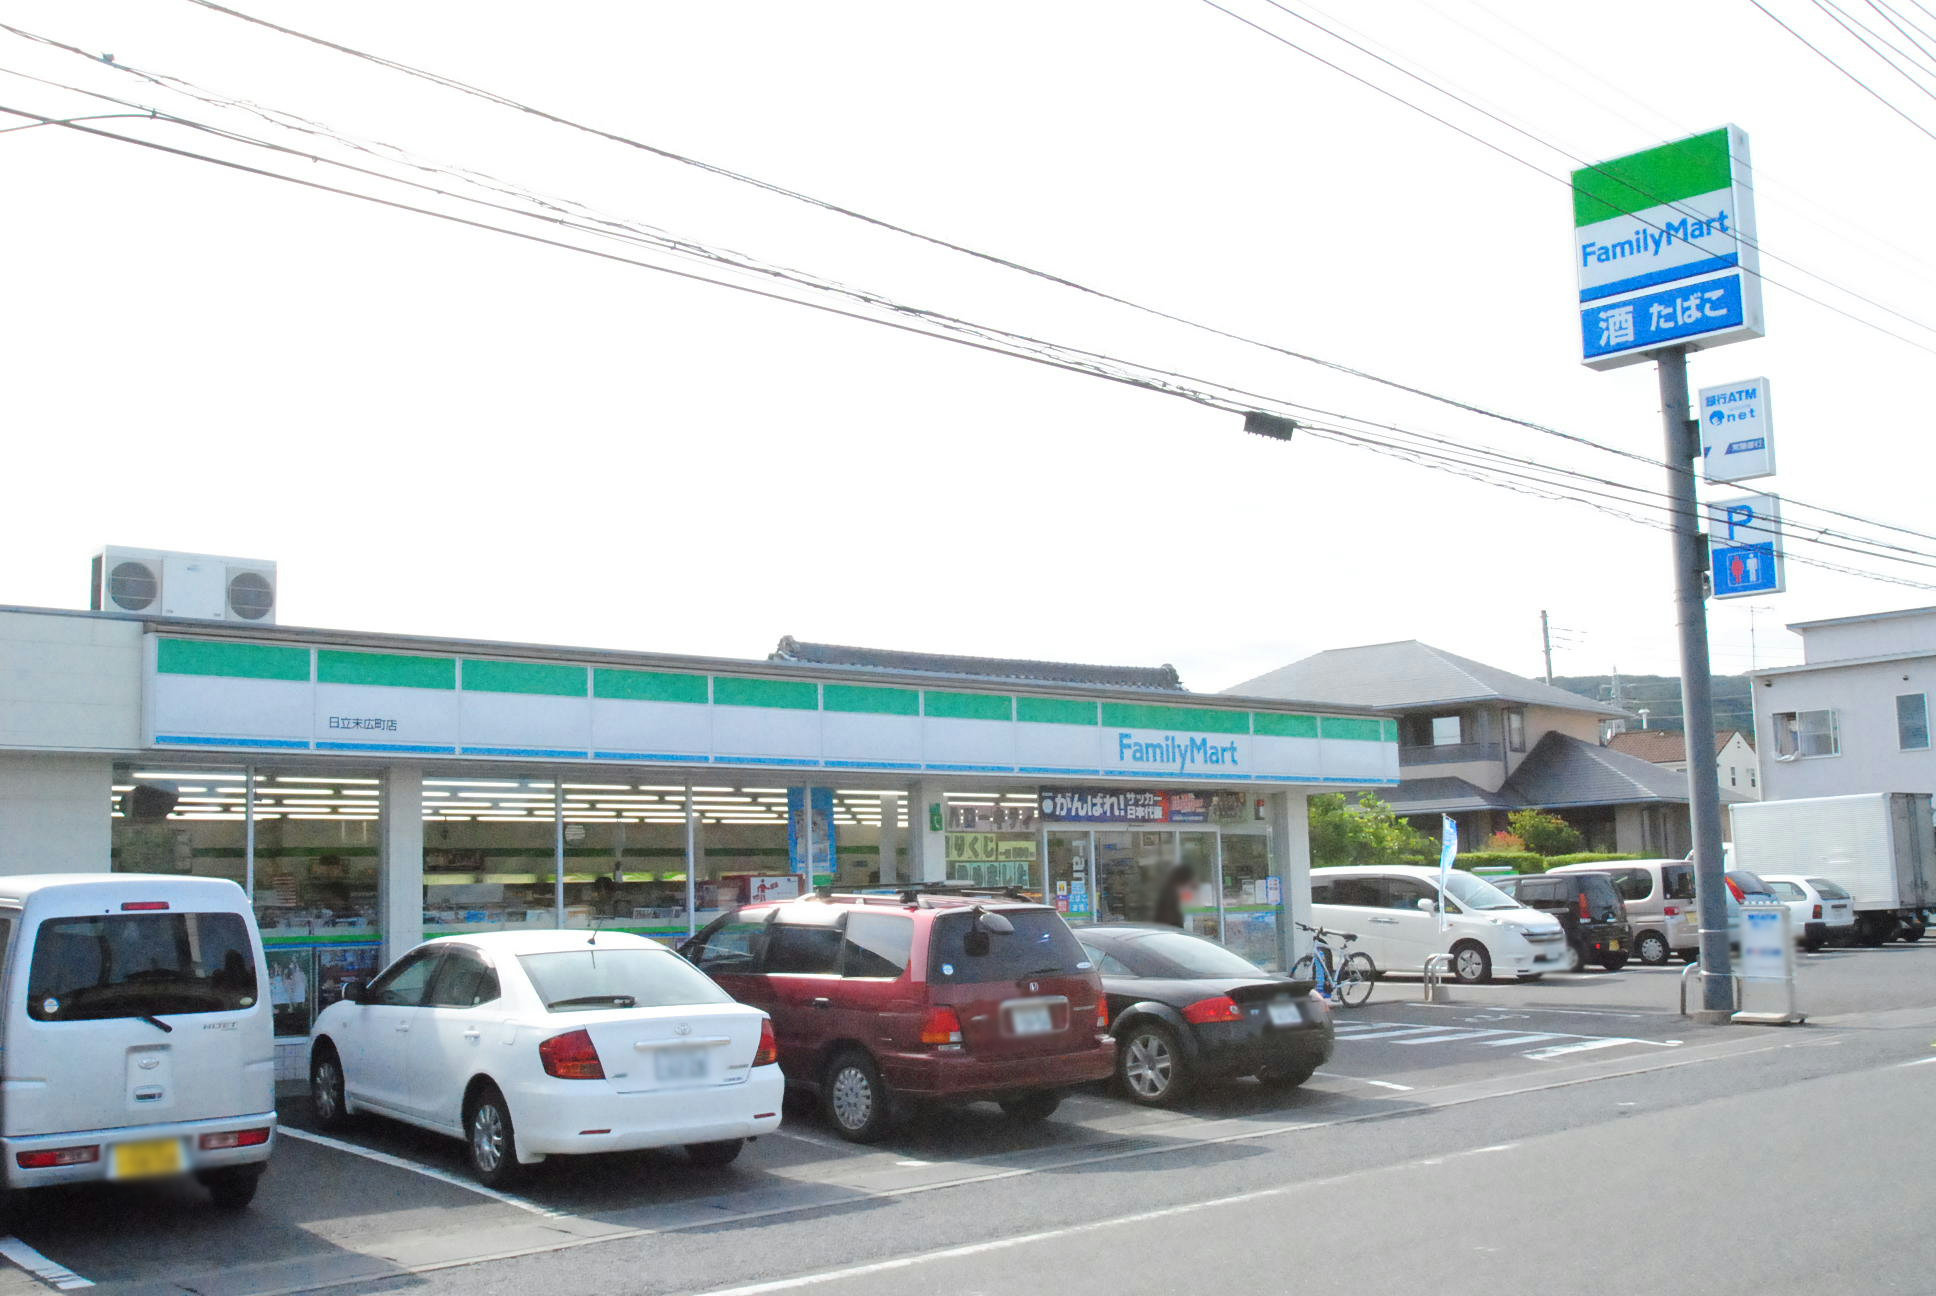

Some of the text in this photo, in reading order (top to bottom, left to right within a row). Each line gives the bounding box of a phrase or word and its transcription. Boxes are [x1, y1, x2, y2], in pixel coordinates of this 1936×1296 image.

[1581, 209, 1729, 267] FamilyMart
[1599, 288, 1728, 347] 酒 たばこ
[1727, 504, 1753, 541] P
[329, 716, 398, 732] 日立末広町店
[1118, 732, 1239, 773] FamilyMart
[1126, 791, 1163, 805] サッカー
